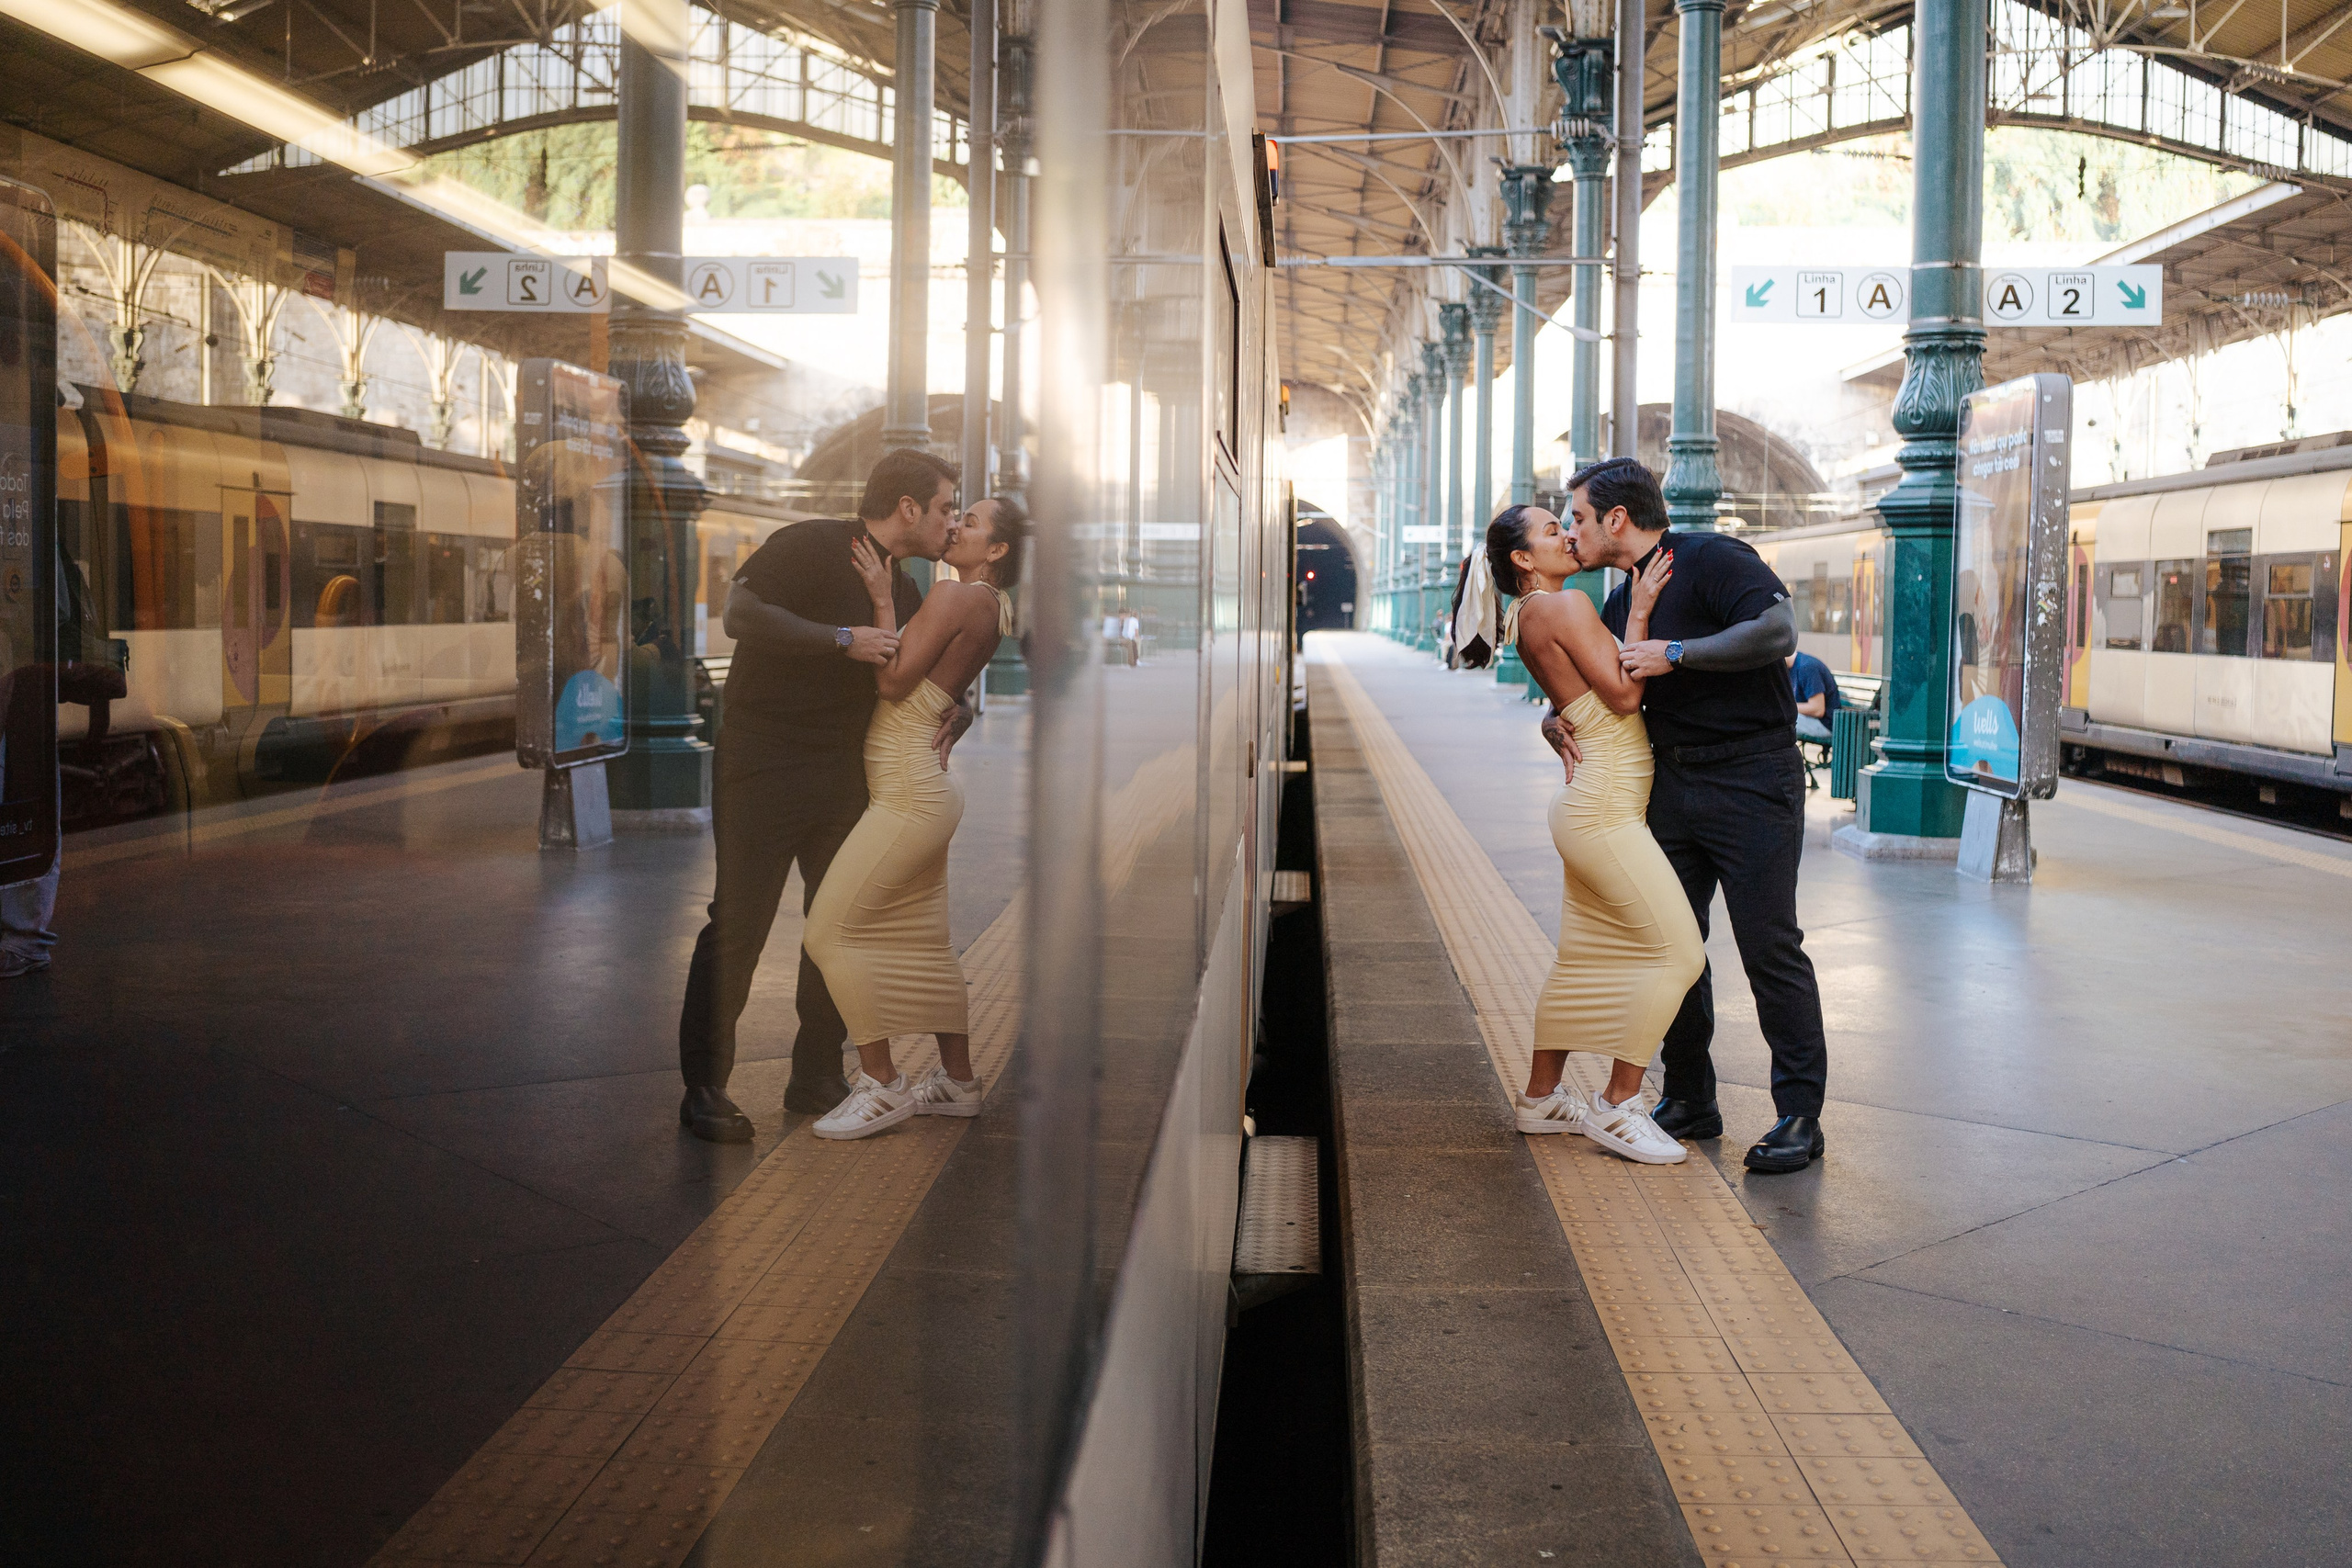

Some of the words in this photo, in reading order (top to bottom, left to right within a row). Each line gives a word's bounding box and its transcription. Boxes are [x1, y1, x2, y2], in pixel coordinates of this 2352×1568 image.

[1804, 273, 1836, 284] Linha
[2055, 275, 2086, 285] Linha
[1814, 288, 1826, 313] 1
[1867, 283, 1892, 310] A
[1997, 285, 2023, 310] A
[2062, 288, 2080, 314] 2
[1974, 708, 1999, 734] wells
